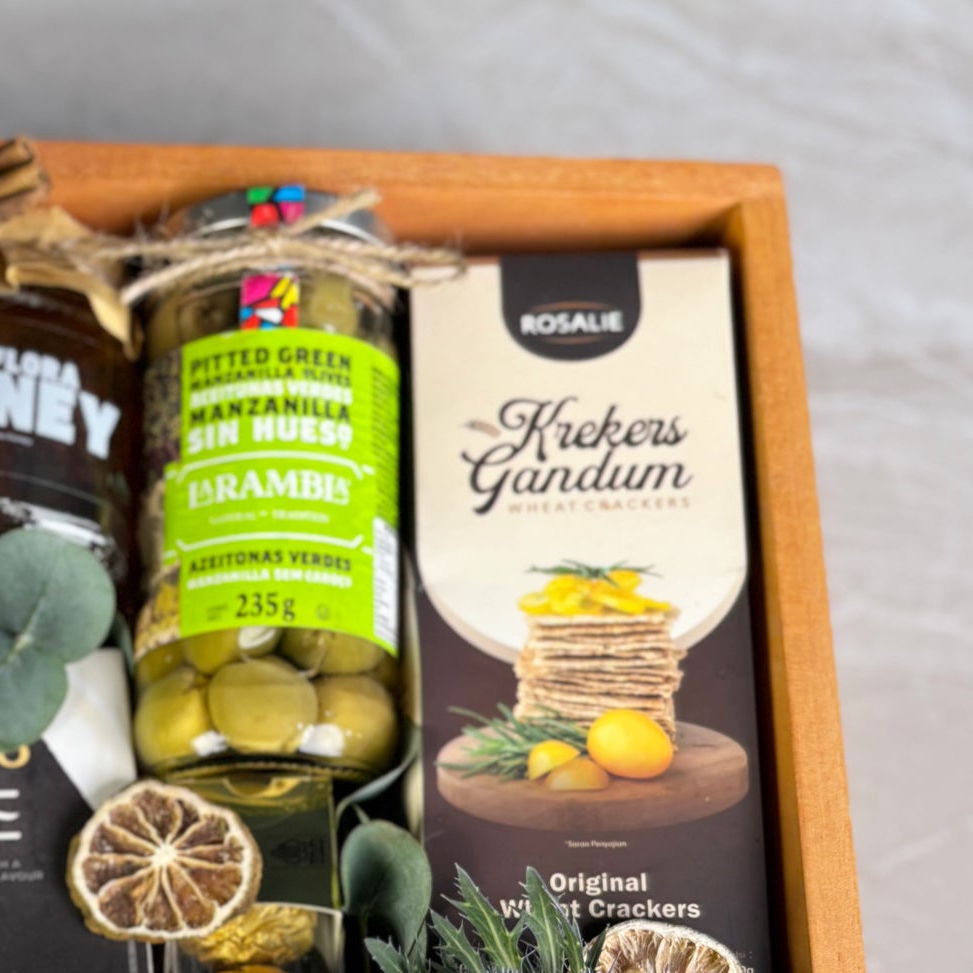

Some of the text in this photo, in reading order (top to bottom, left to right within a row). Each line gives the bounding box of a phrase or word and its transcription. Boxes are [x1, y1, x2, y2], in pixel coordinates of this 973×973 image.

[520, 311, 624, 336] ROSALIE
[191, 348, 351, 372] PITTED GREEN
[191, 398, 351, 424] MANZANILLA
[187, 419, 239, 454] SIN
[498, 396, 689, 462] Krekers
[460, 442, 694, 516] Gandum
[507, 497, 691, 514] WHEAT CRACKERS
[190, 549, 352, 573] AZEITONAS VERDES
[549, 872, 647, 896] Original
[588, 899, 701, 919] Crackers
